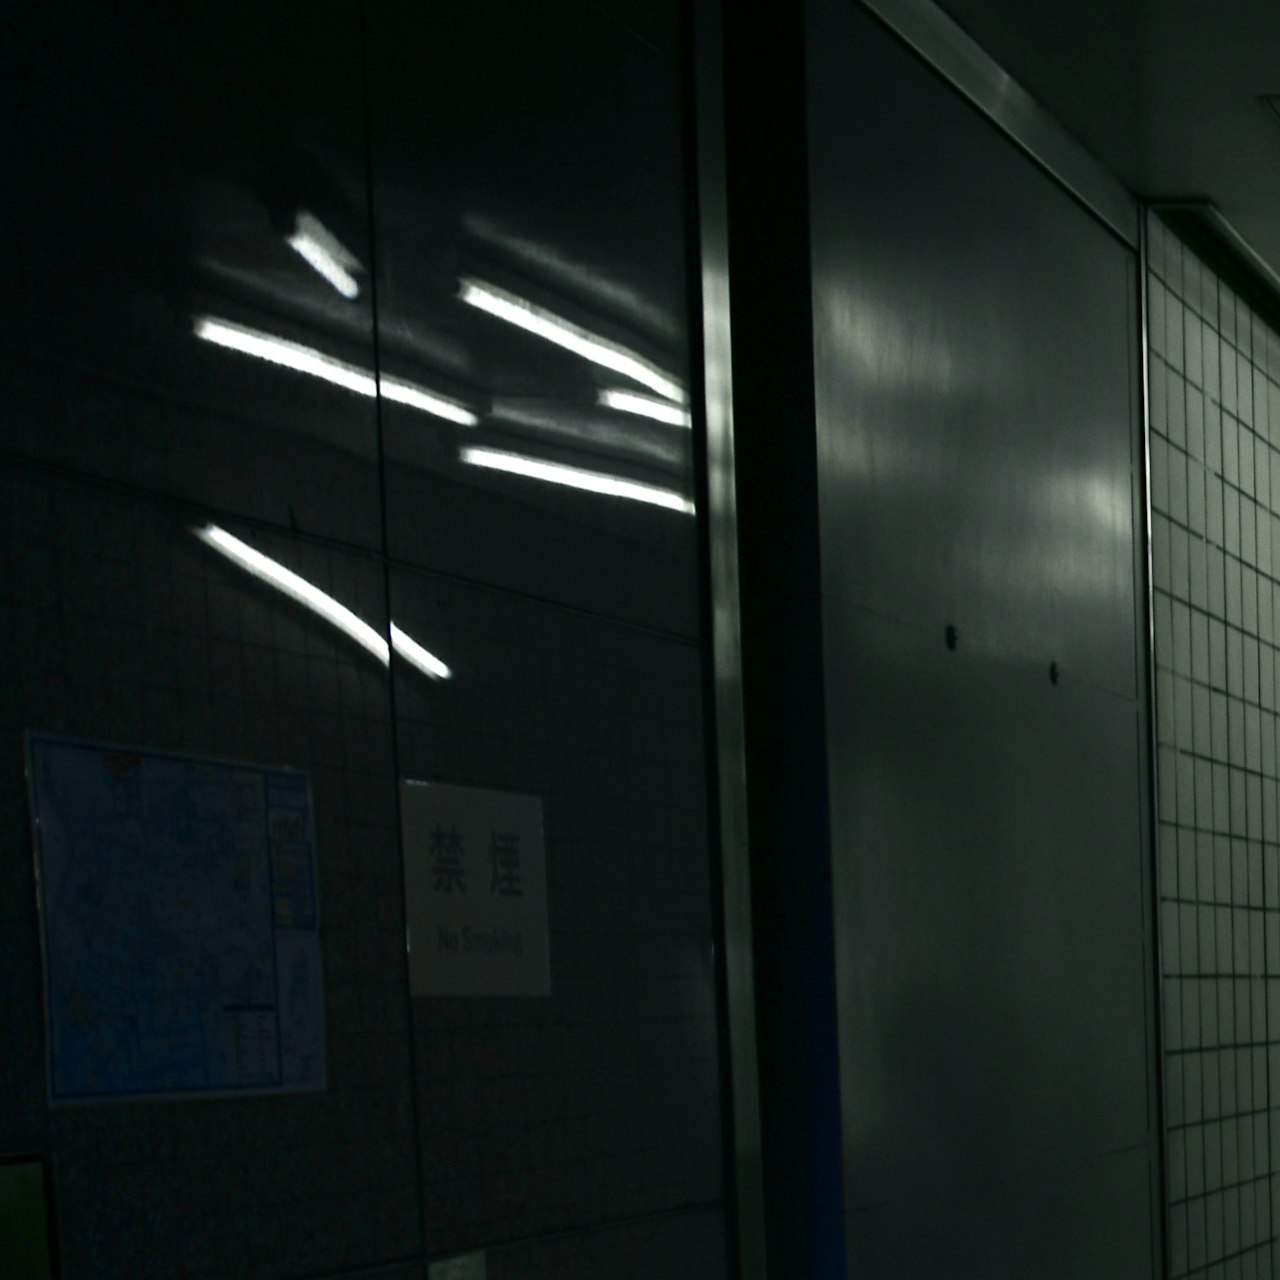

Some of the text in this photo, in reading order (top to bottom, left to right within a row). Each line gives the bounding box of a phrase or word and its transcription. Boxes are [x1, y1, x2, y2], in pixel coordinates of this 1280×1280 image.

[429, 822, 524, 898] 禁煙
[437, 925, 523, 960] No Smoking
